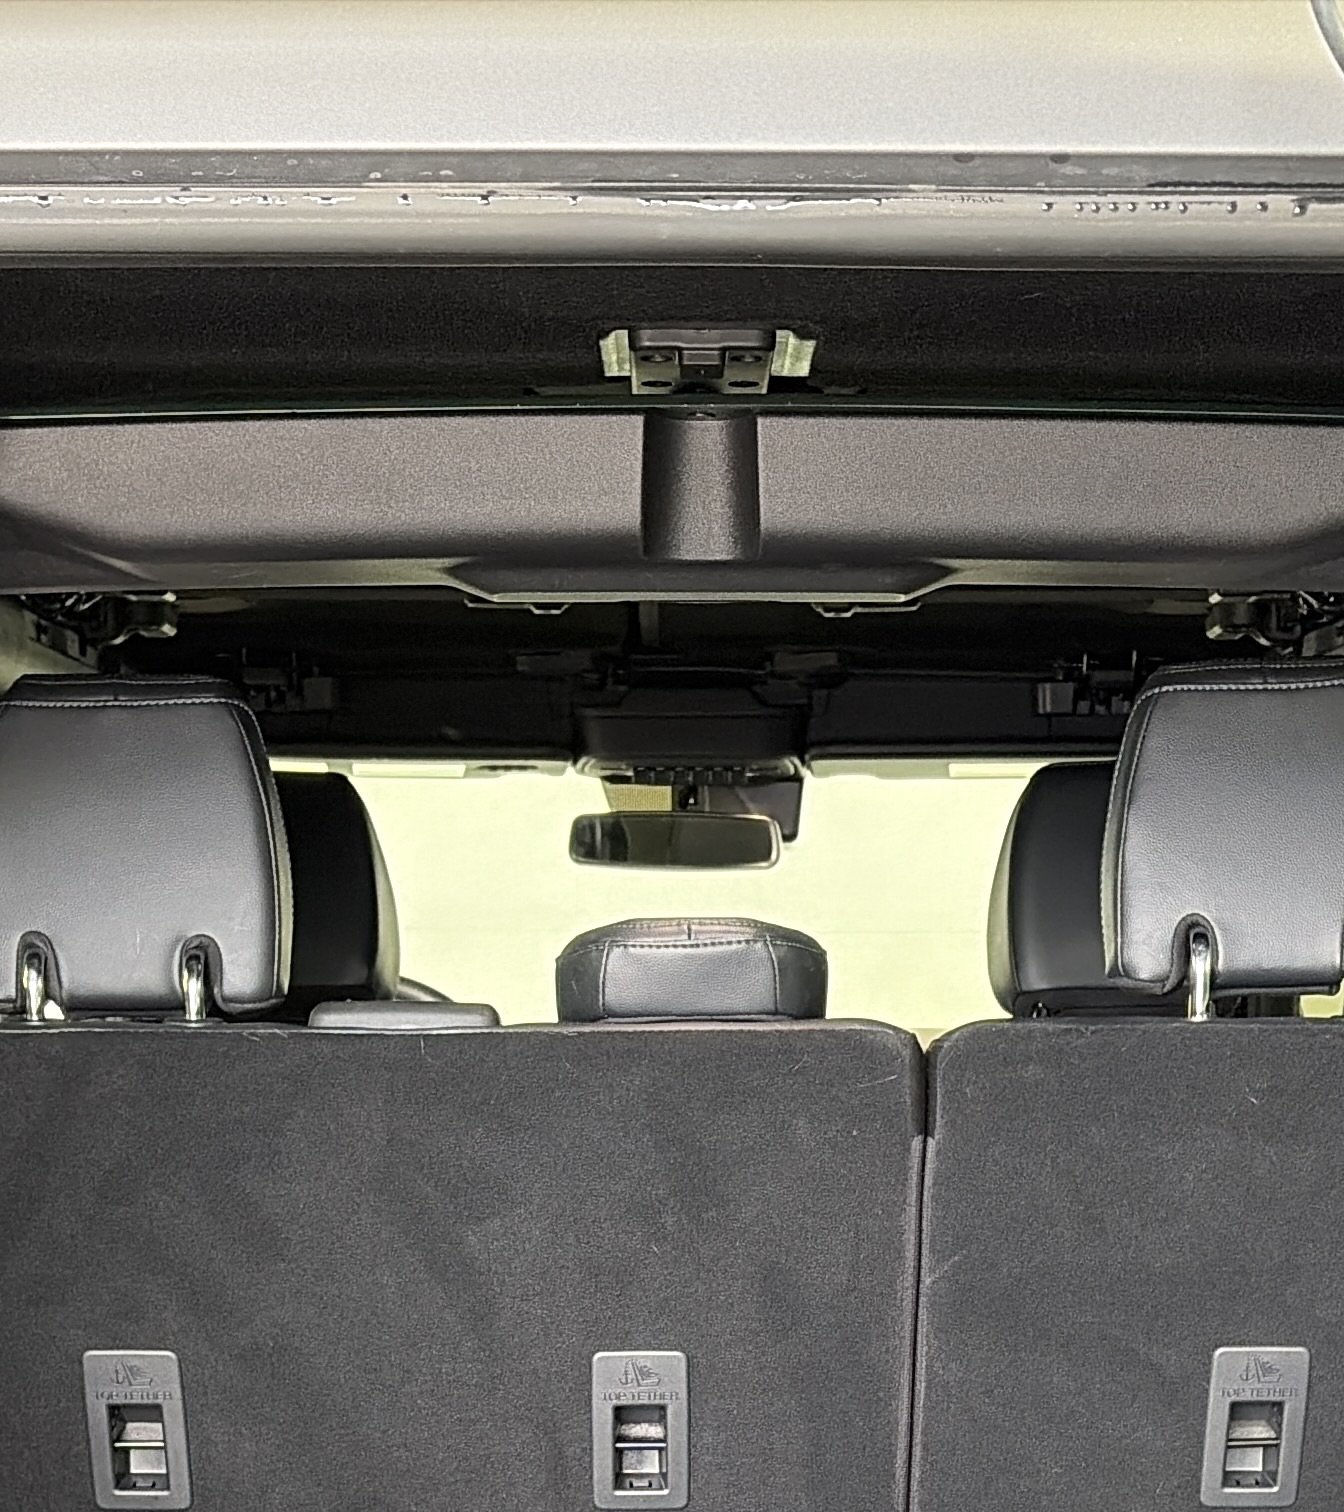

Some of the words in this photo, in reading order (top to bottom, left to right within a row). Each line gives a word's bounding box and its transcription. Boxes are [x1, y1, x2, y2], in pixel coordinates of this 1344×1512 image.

[95, 1391, 119, 1401] TOP
[600, 1391, 627, 1401] TOP
[1219, 1387, 1246, 1398] TOP
